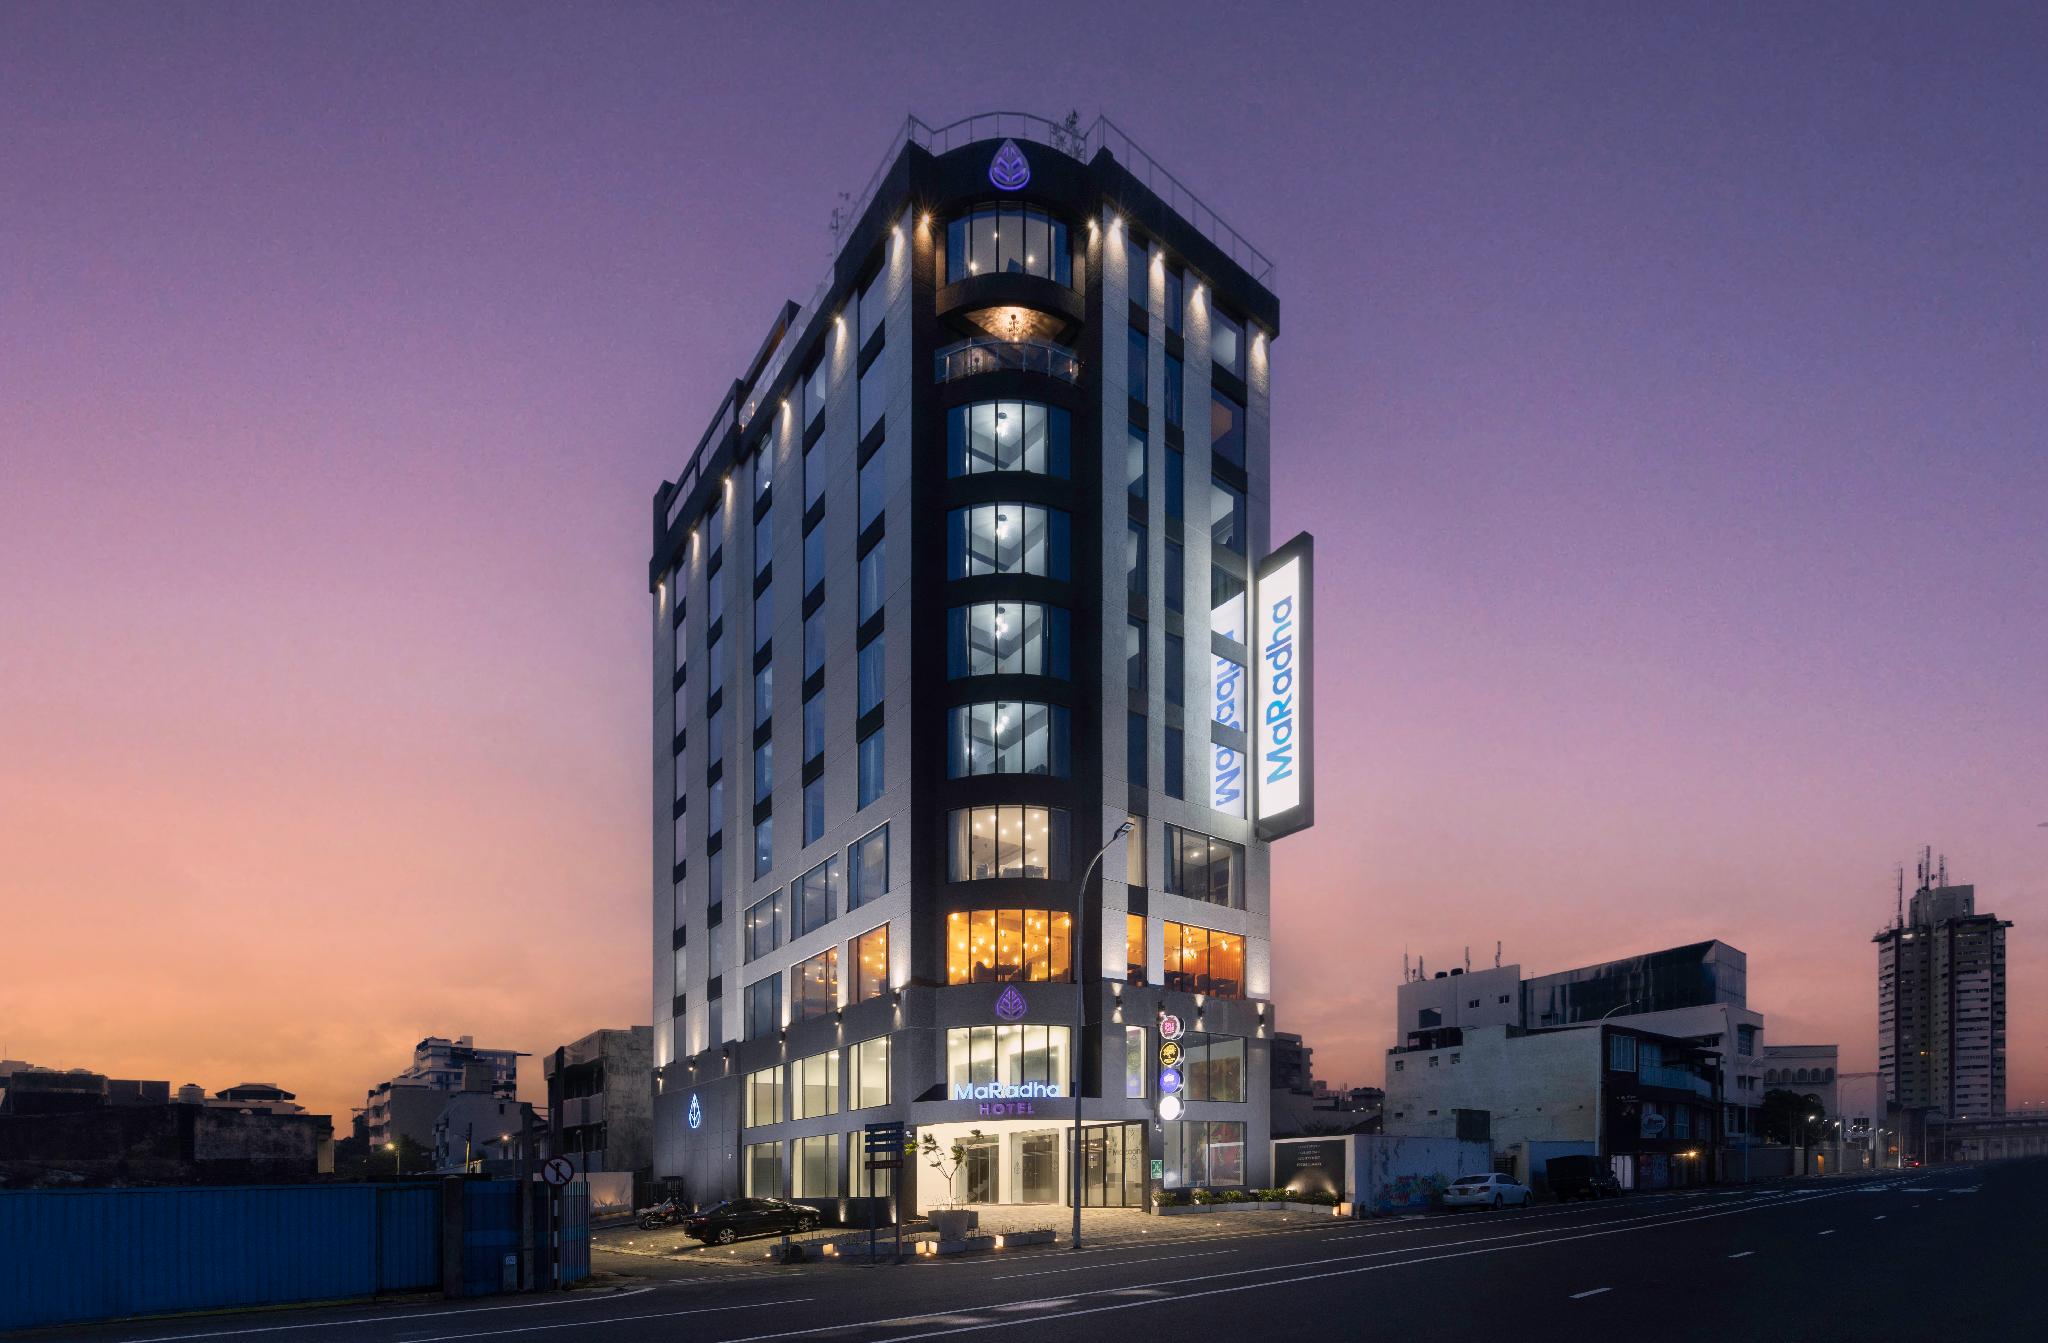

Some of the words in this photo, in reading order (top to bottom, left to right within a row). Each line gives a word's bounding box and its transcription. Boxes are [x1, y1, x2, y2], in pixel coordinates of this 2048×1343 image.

[1266, 595, 1293, 785] MaRadha
[955, 1081, 1060, 1100] MaRadha
[980, 1102, 1035, 1115] HOTEL
